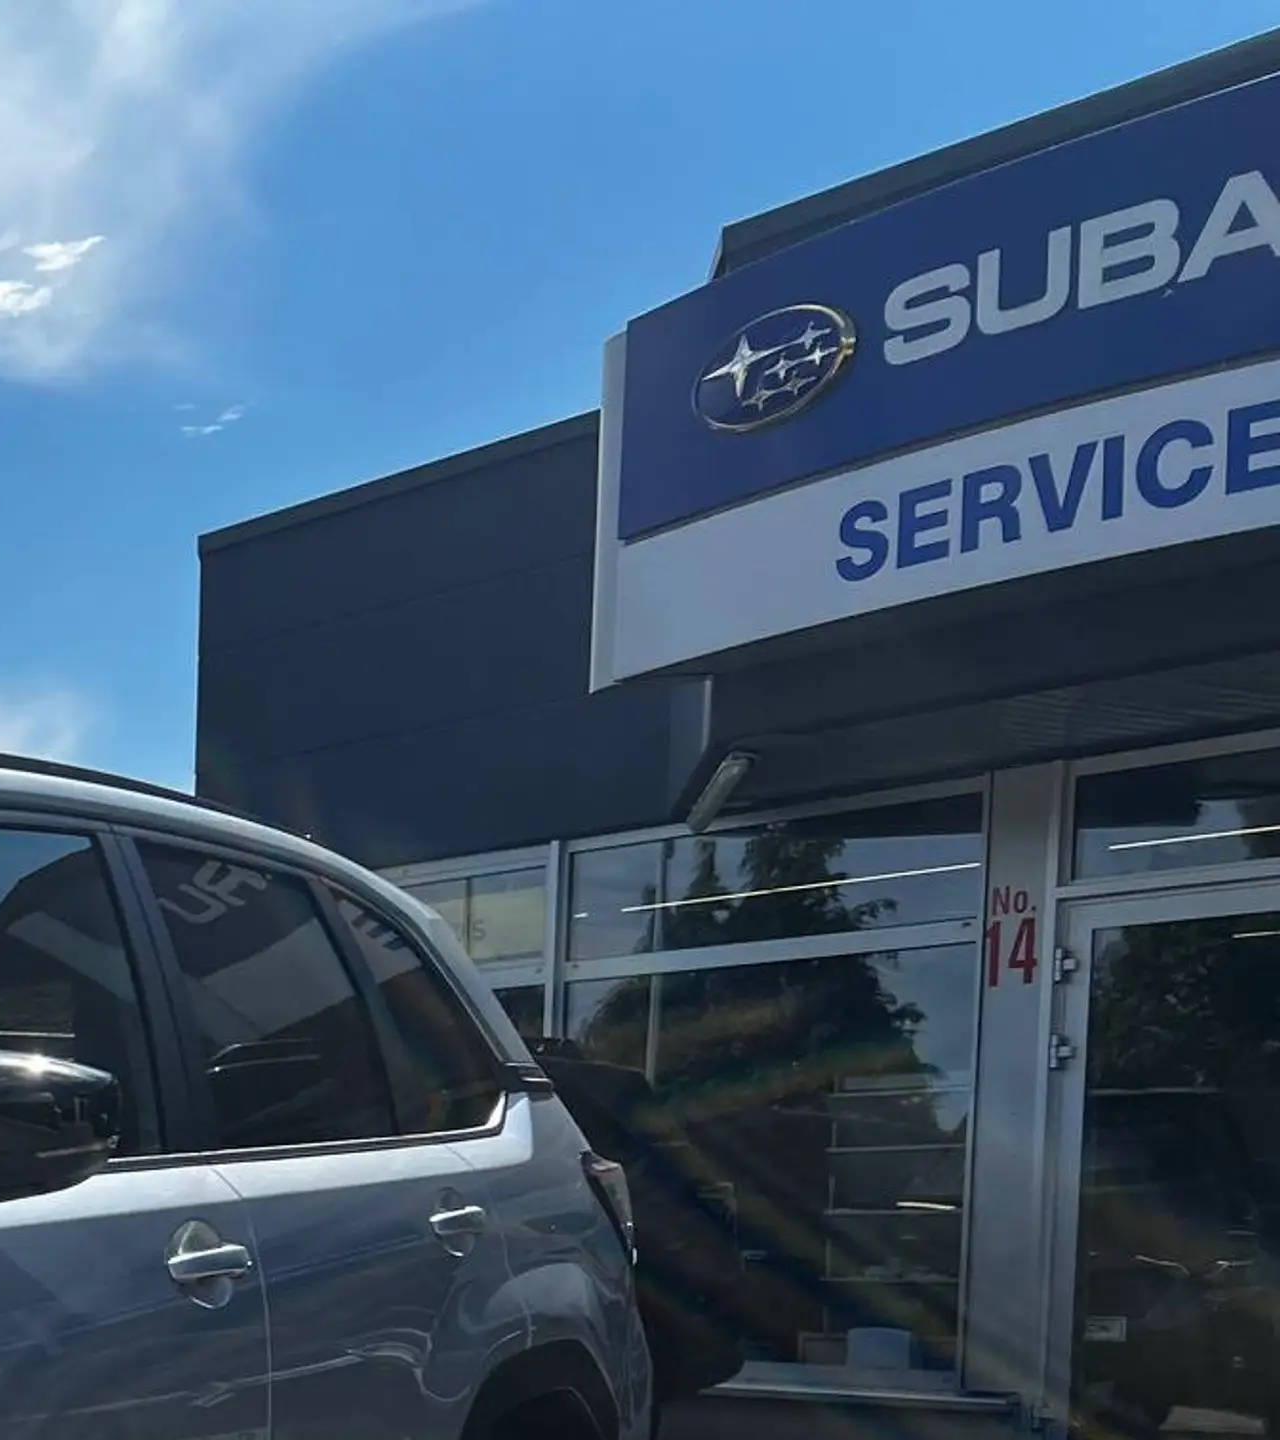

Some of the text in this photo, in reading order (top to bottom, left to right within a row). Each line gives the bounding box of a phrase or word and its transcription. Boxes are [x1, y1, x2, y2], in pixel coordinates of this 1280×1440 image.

[884, 170, 1280, 366] SUBA
[836, 399, 1280, 582] SERVICE
[986, 918, 1038, 988] 14
[992, 886, 1037, 916] No.
